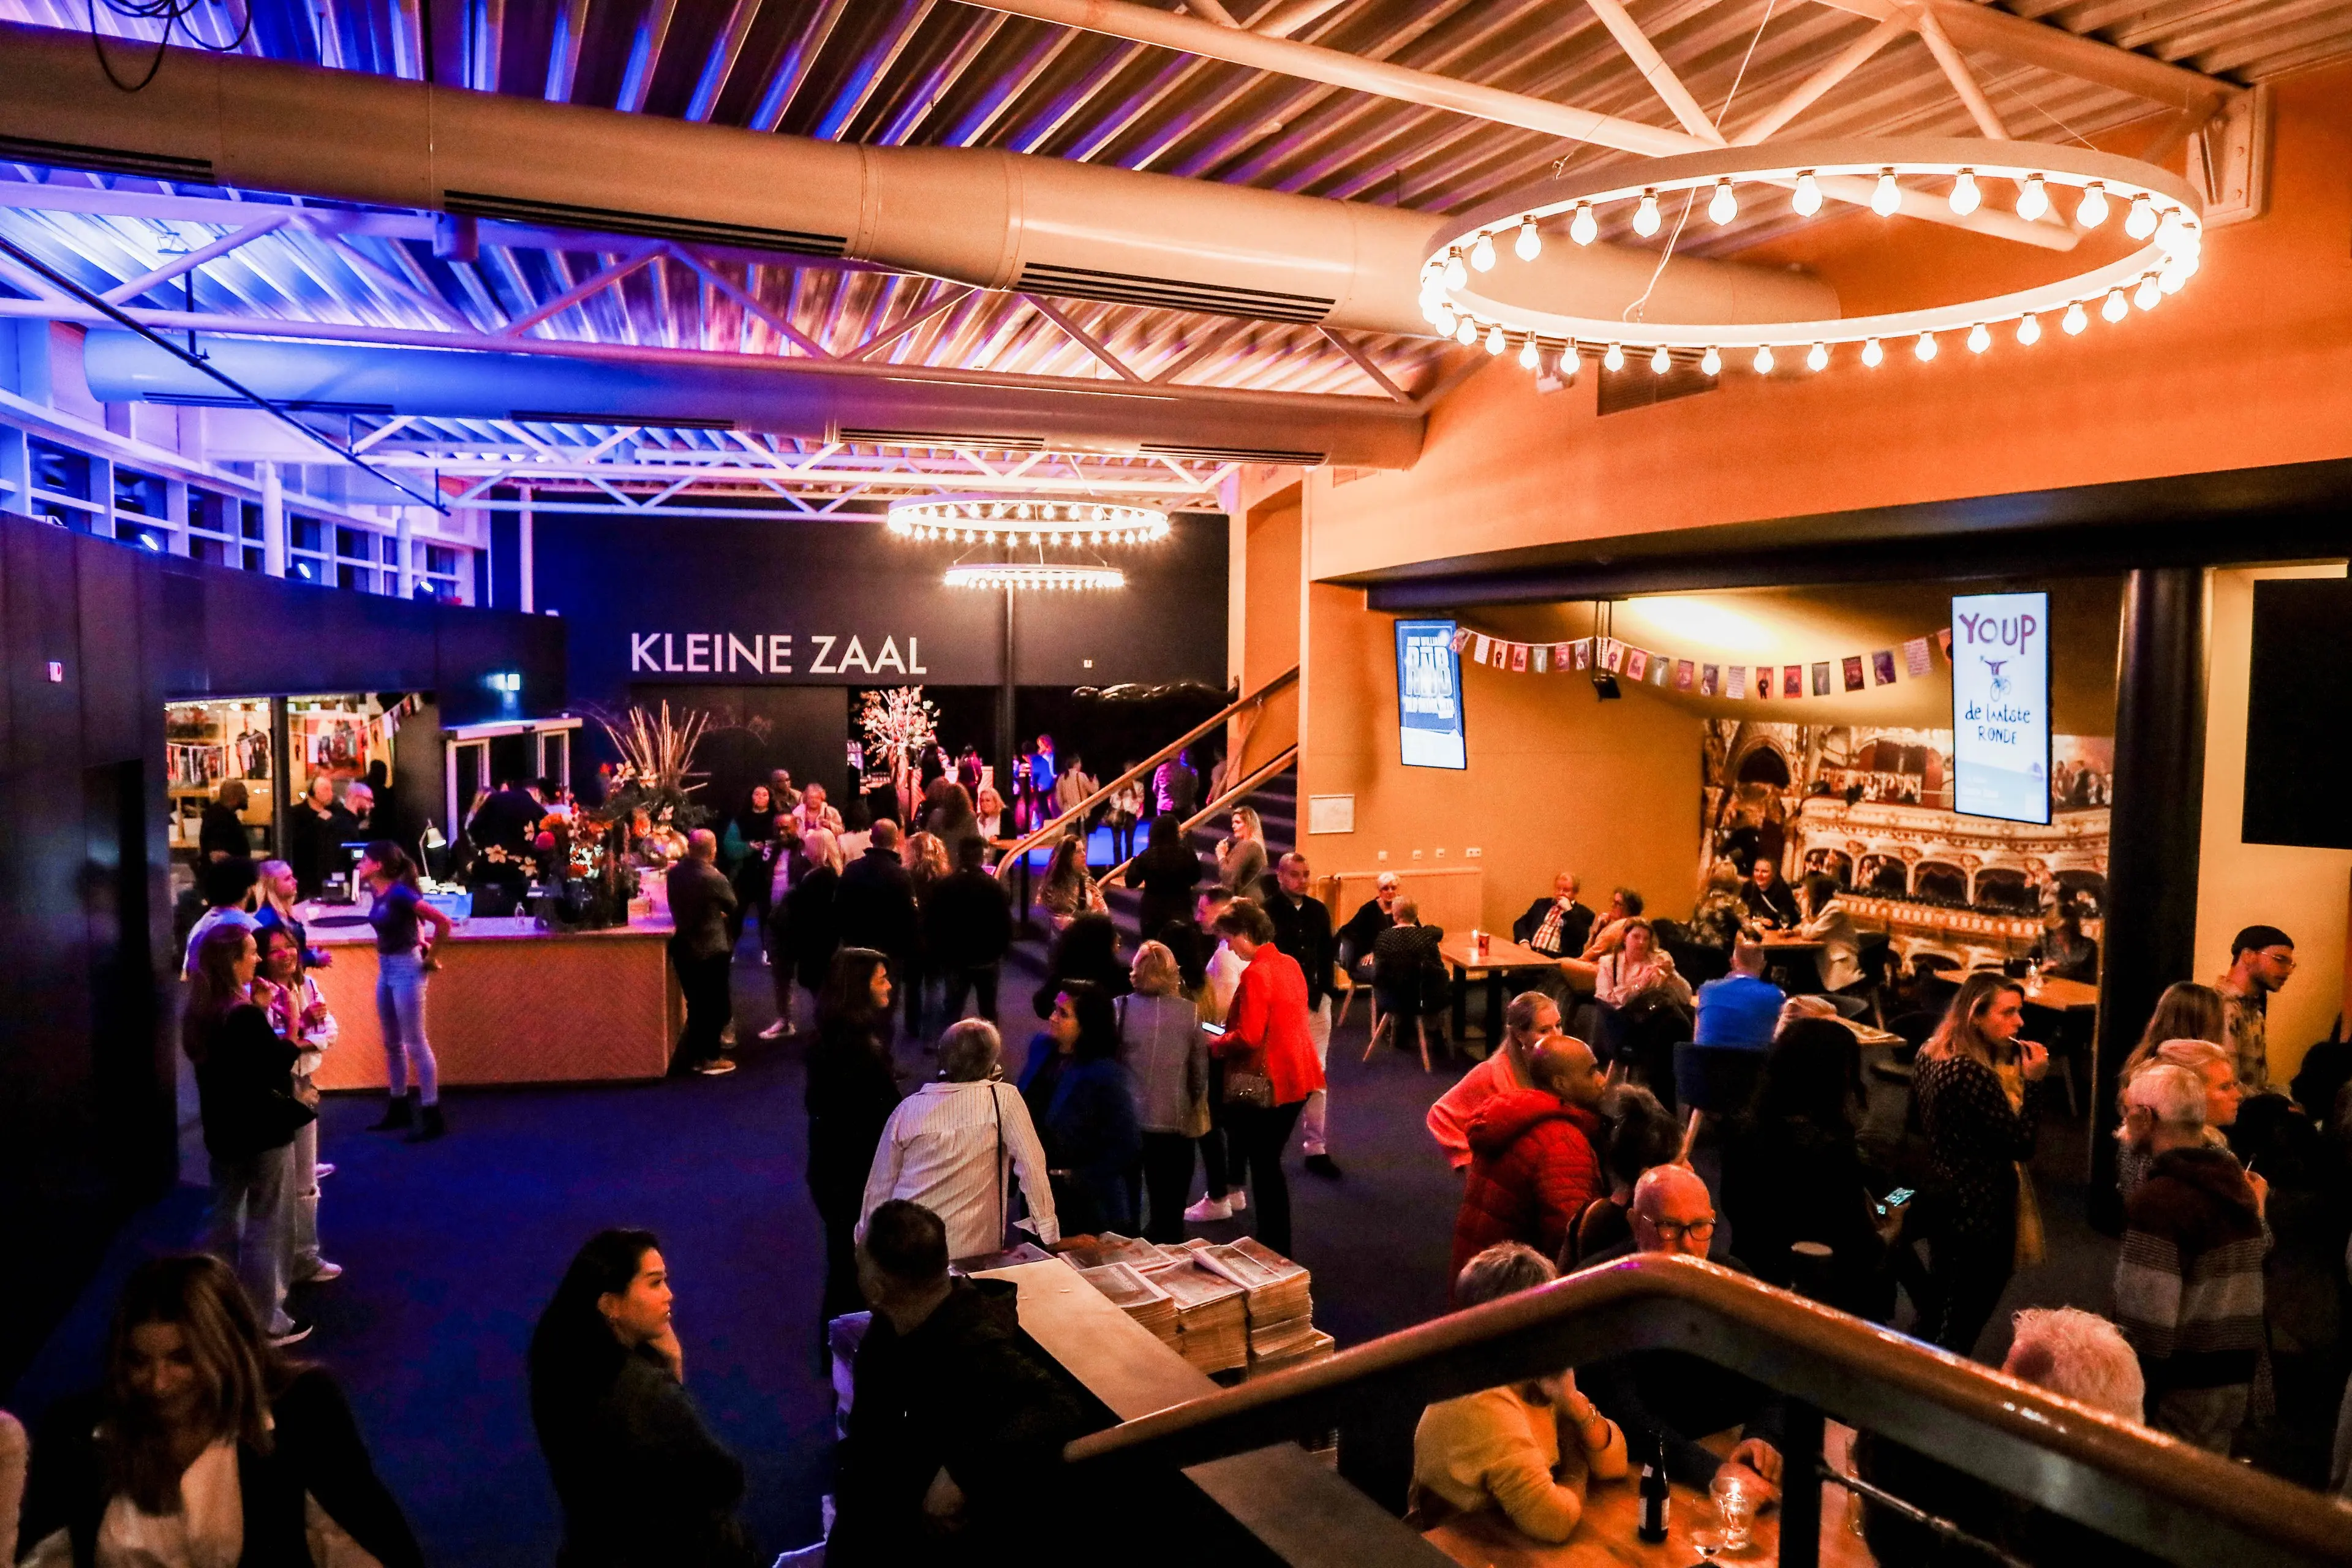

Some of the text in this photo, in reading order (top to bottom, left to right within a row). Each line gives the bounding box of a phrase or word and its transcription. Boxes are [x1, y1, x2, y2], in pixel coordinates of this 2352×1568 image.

[1958, 613, 2037, 655] YOUP
[631, 633, 927, 674] KLEINE ZAAL
[1965, 699, 1981, 720] de
[1978, 725, 2017, 744] RONDE
